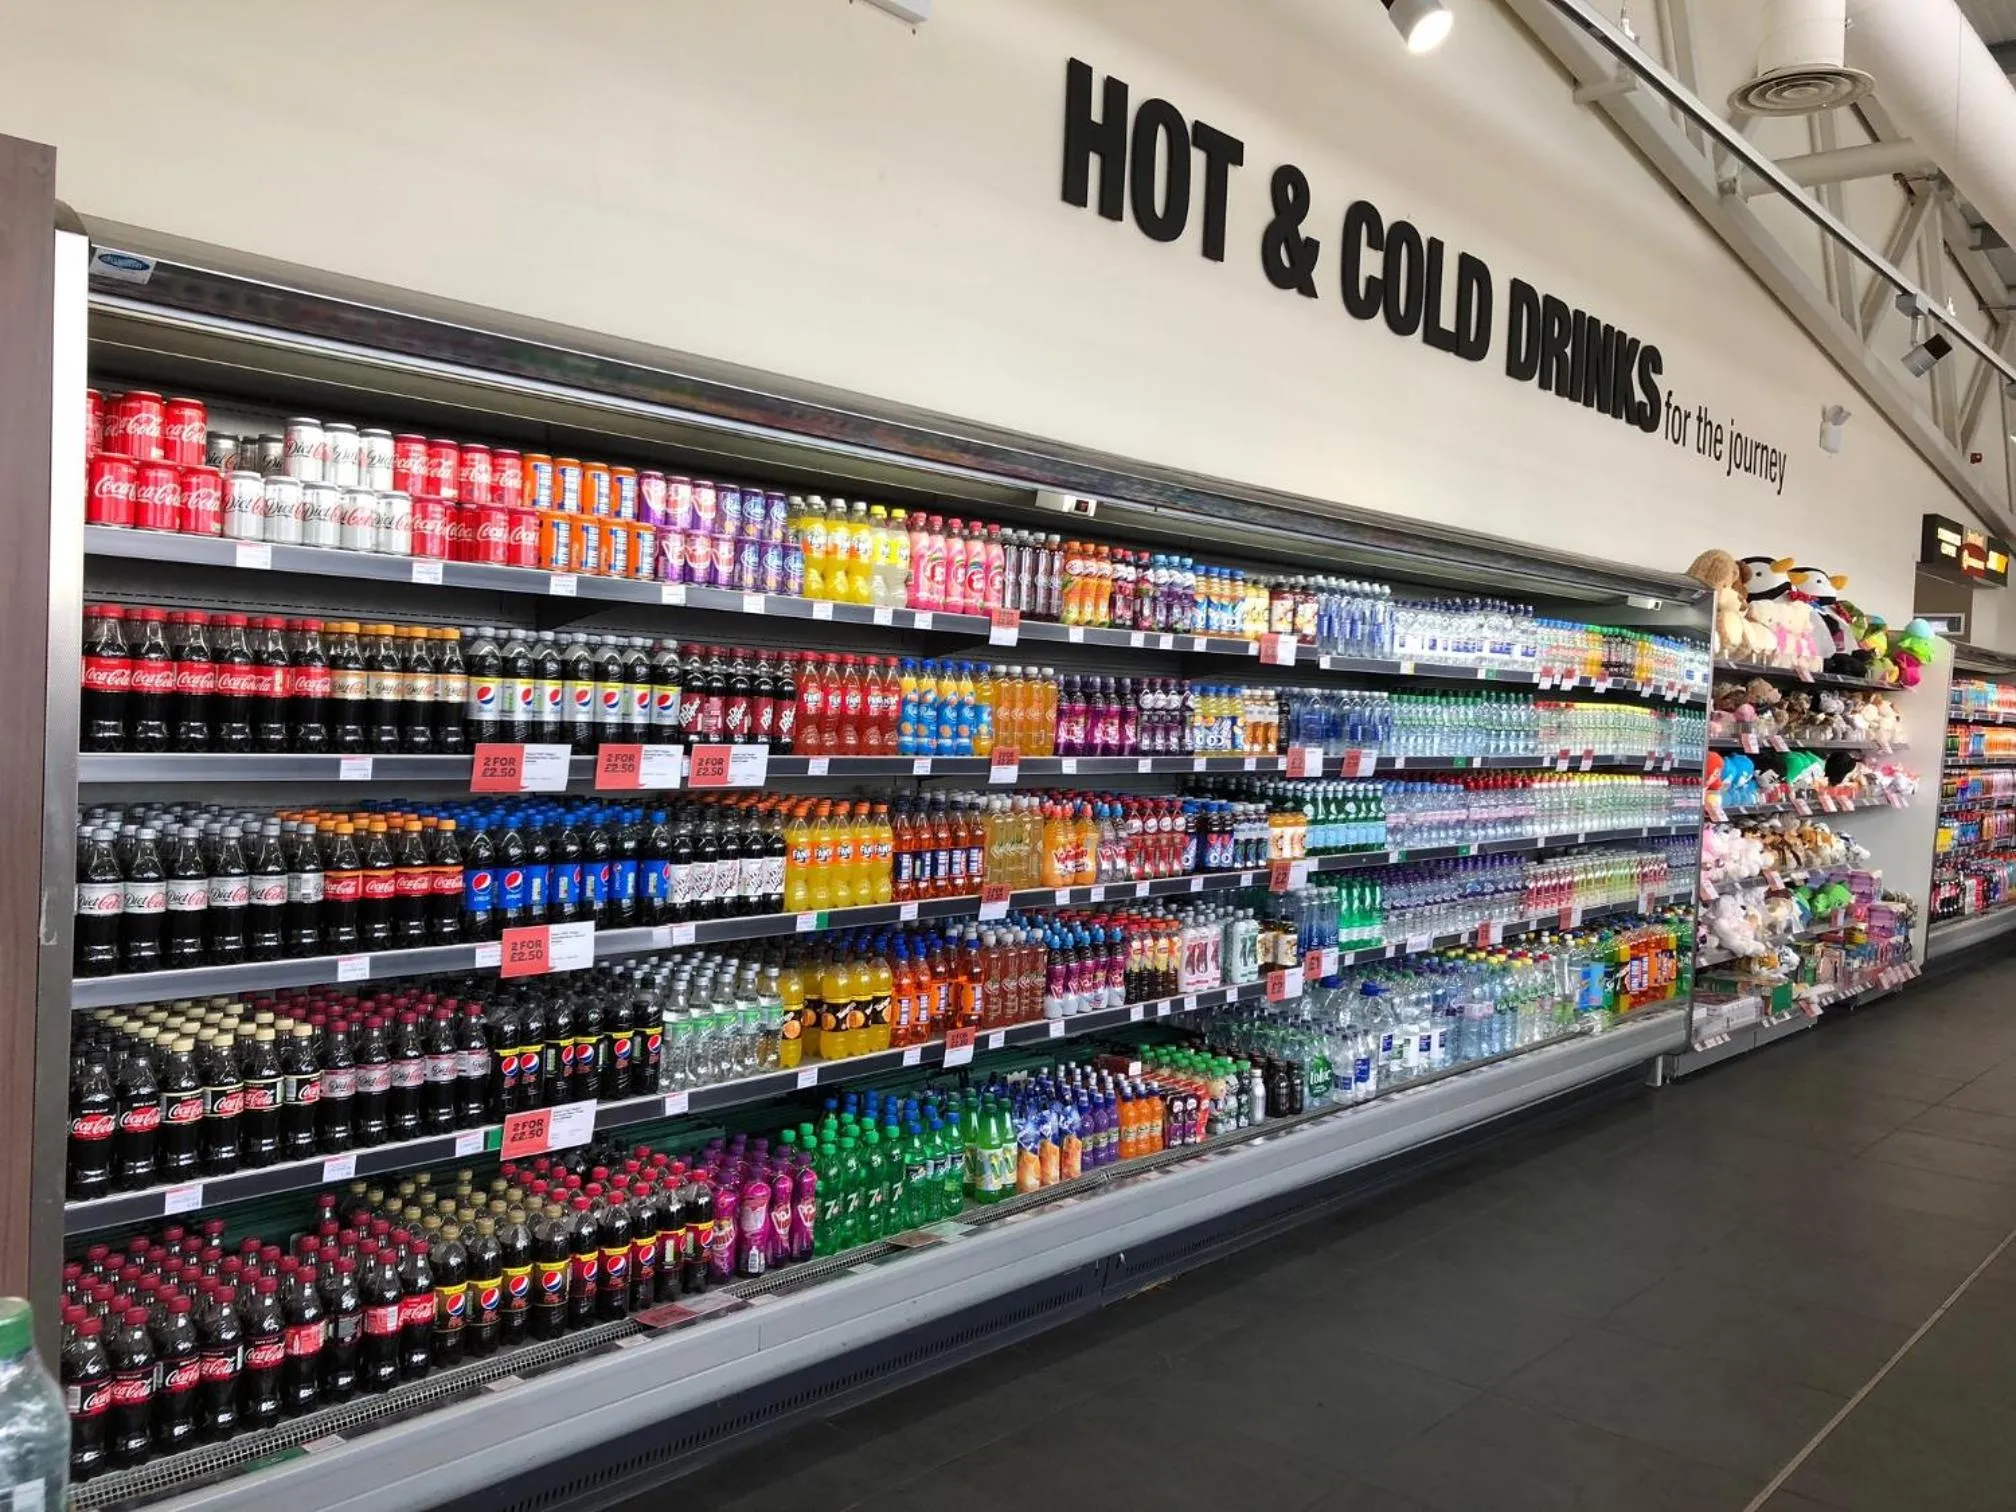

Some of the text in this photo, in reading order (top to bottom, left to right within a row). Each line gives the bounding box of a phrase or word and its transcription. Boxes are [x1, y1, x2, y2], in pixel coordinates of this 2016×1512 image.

[1062, 57, 1787, 496] HOT & COLD DRINKS for the journey
[483, 758, 491, 767] 2
[493, 757, 516, 767] FOR
[607, 754, 614, 763] 2
[615, 753, 635, 763] FOR
[698, 758, 704, 767] 2
[705, 757, 724, 767] FOR
[481, 767, 517, 778] £2.50
[604, 763, 635, 774] £2.50
[696, 766, 724, 777] £2.50
[511, 939, 543, 951] 2 FOR
[509, 949, 544, 962] £2.50
[513, 1118, 544, 1132] 2 FOR
[510, 1128, 544, 1143] £2.50
